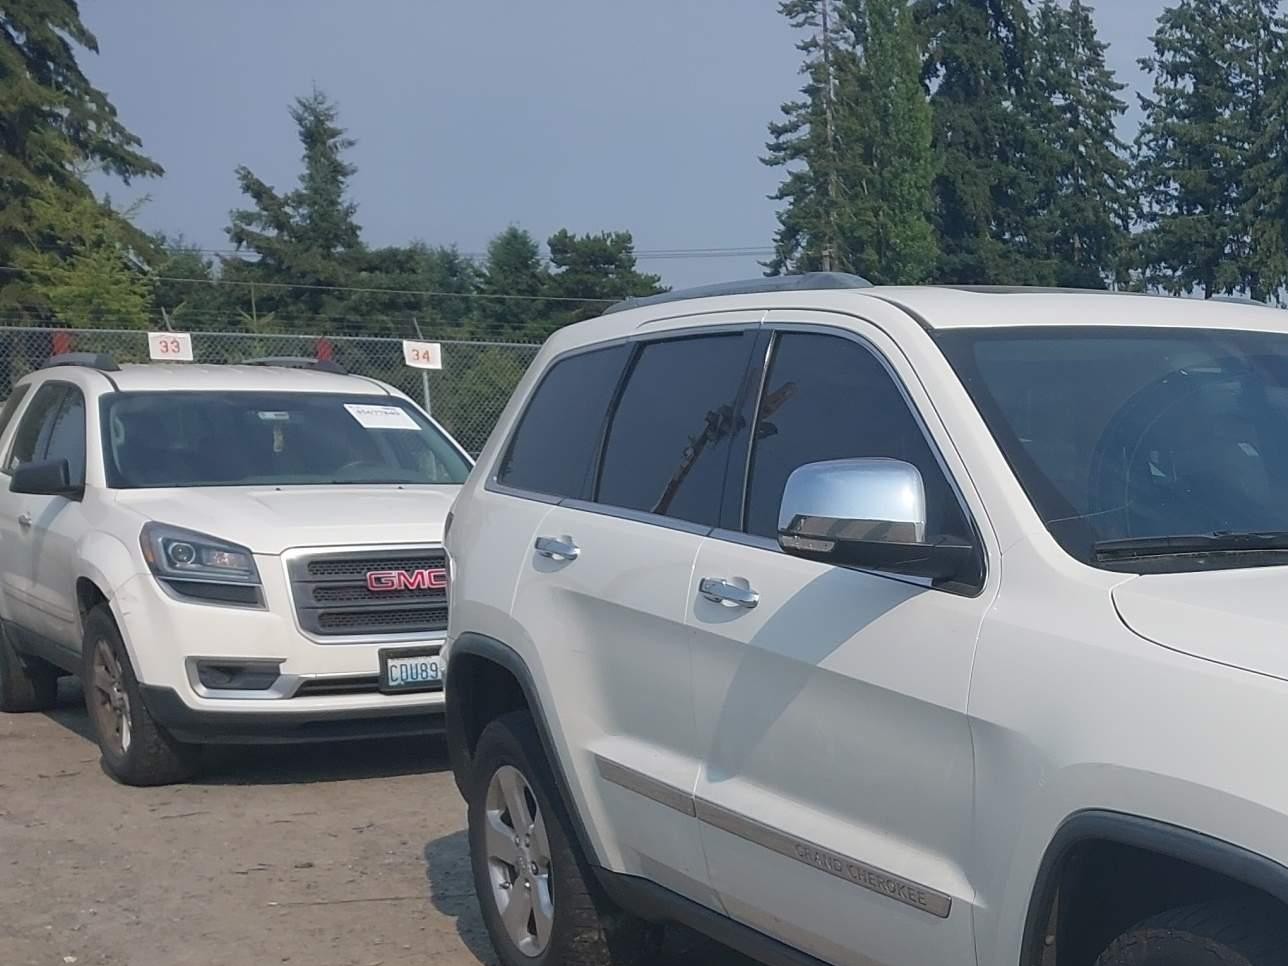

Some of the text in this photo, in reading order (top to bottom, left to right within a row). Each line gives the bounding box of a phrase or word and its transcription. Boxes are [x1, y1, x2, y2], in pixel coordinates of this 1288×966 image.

[159, 340, 180, 353] 33
[411, 349, 430, 362] 34
[366, 568, 447, 591] GMC
[389, 662, 439, 682] CDU89
[794, 844, 928, 906] GRAND CHEROKEE
